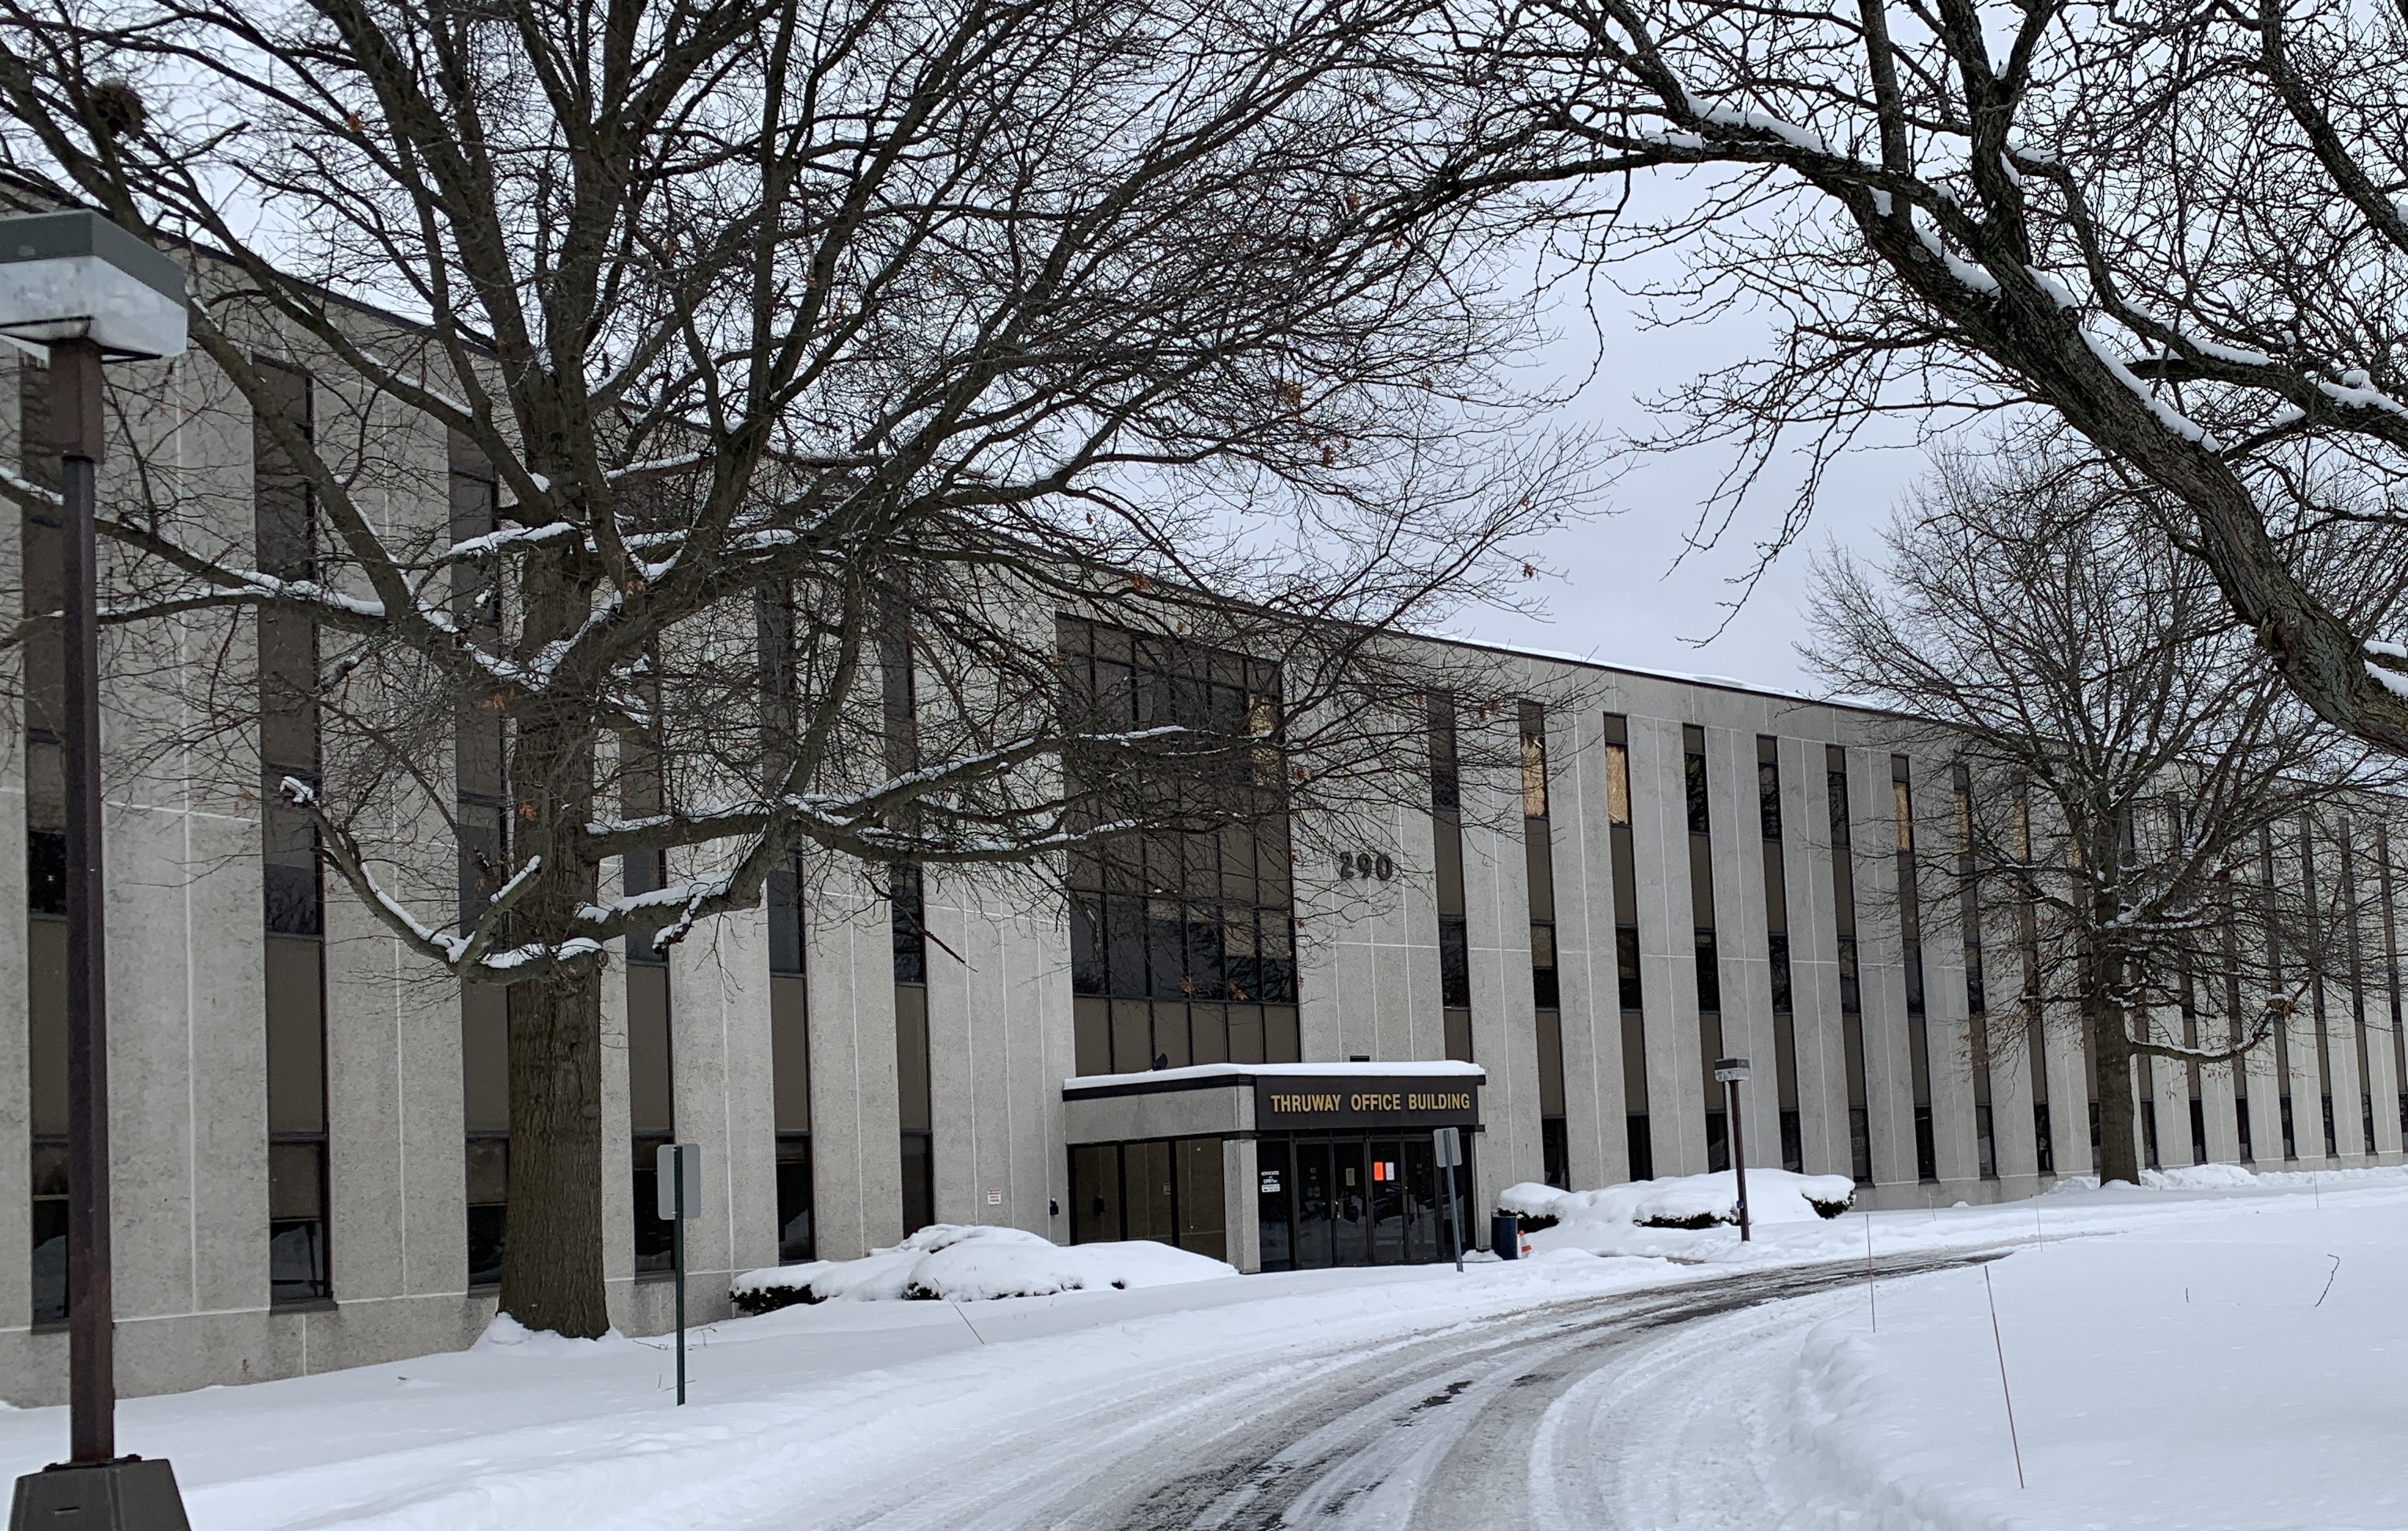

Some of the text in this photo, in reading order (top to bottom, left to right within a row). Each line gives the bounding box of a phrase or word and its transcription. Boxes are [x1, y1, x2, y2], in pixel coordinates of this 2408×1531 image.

[1340, 852, 1393, 880] 290
[1270, 1093, 1470, 1112] THRUWAY OFFICE BUILDING
